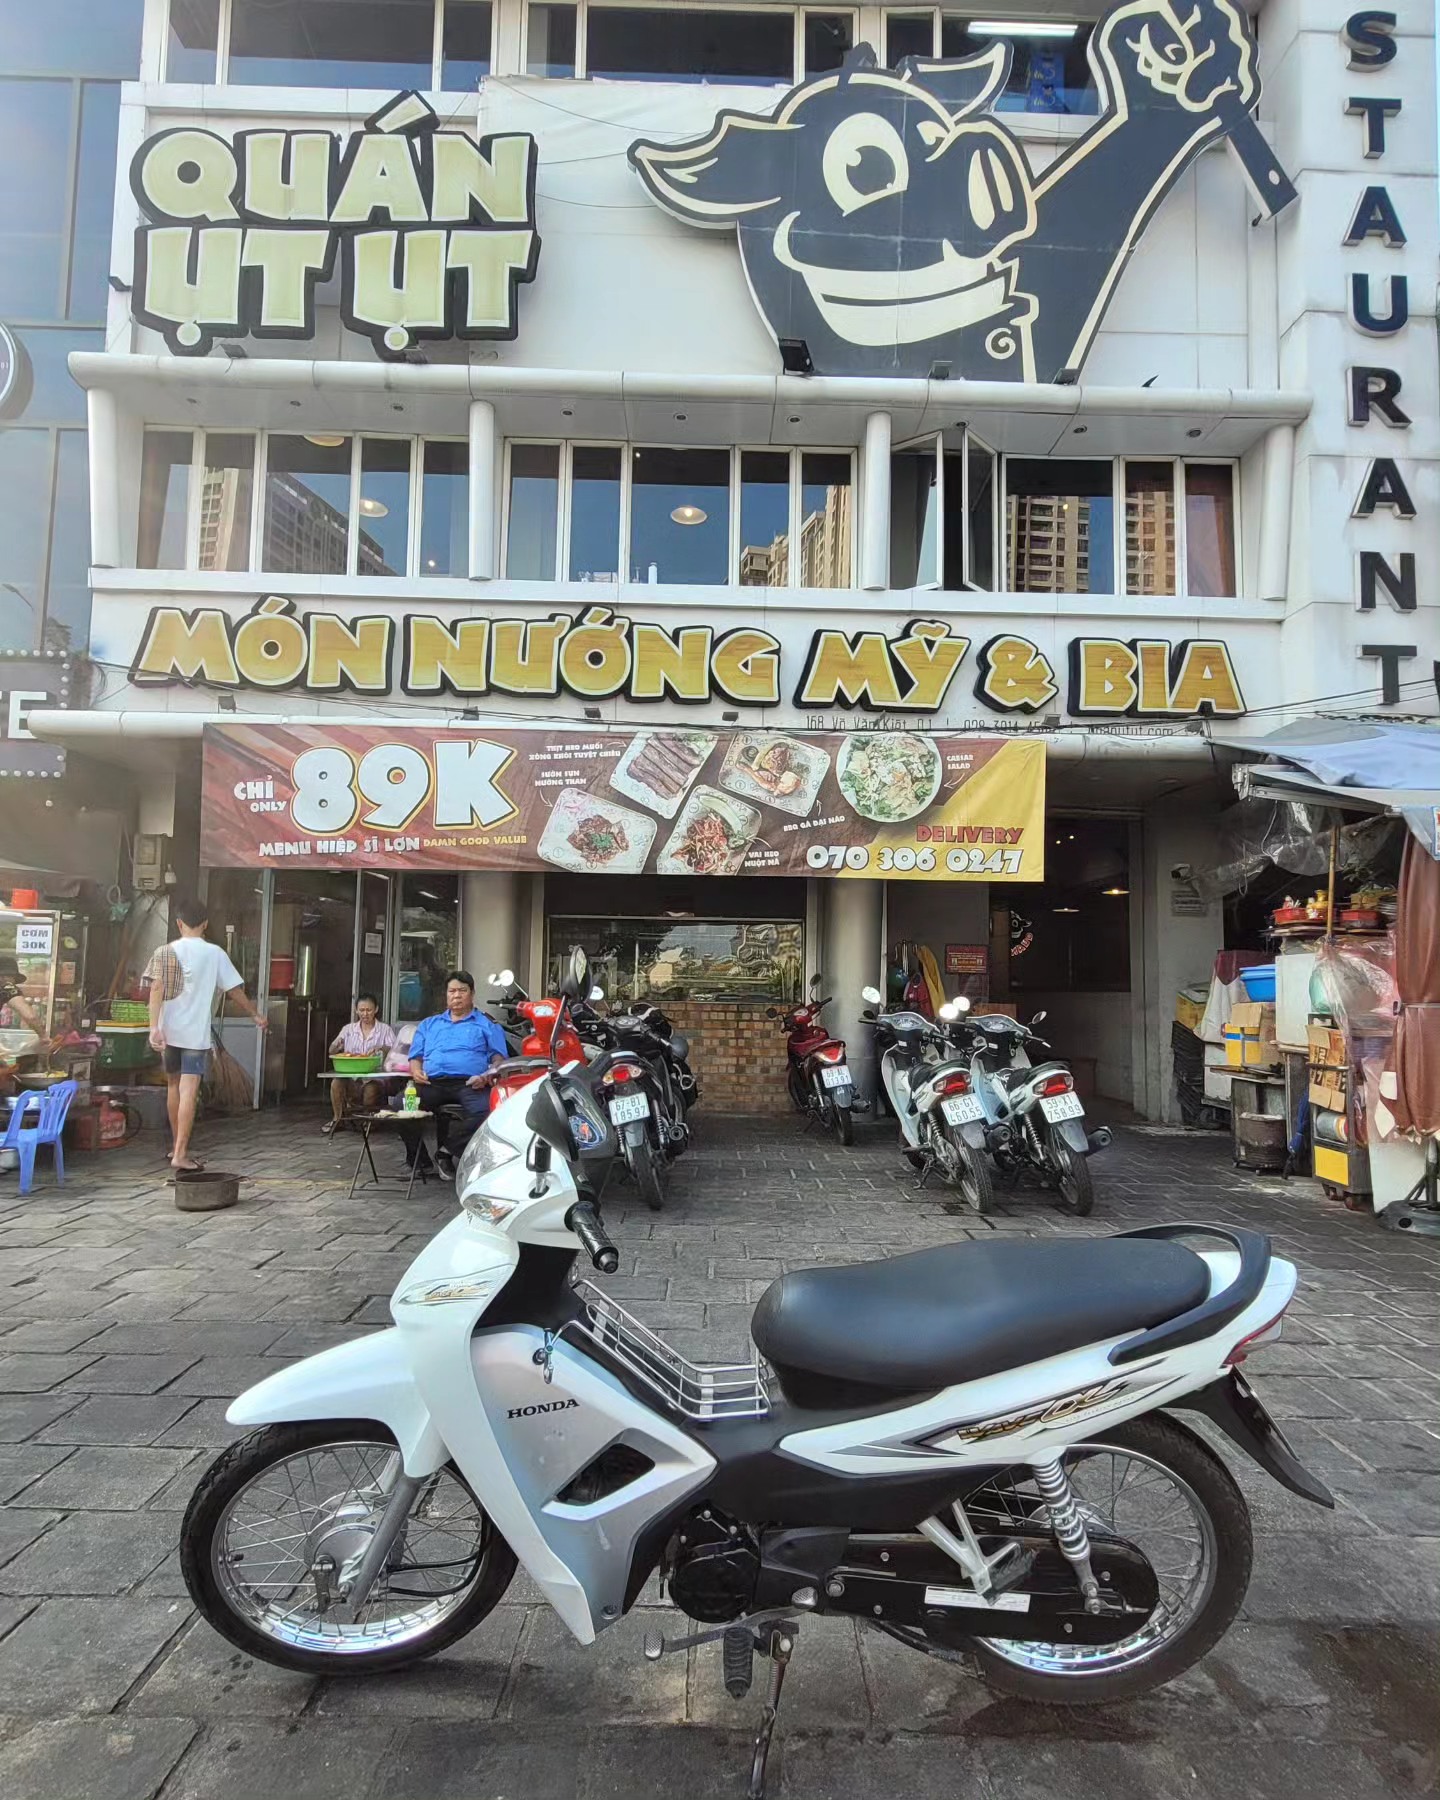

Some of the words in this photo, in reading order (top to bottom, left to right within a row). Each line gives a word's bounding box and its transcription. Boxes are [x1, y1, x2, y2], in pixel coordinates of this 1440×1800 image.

[134, 92, 536, 225] QUÁN
[140, 228, 333, 350] ỤT
[349, 229, 536, 353] ỤT
[132, 594, 394, 691] MÓN
[403, 606, 781, 705] NƯỚNG
[796, 618, 971, 712] MỸ
[977, 634, 1059, 712] &
[1070, 637, 1247, 716] BIA
[806, 715, 824, 730] 168
[947, 762, 971, 770] SALAD
[233, 774, 274, 801] CHỈ
[292, 739, 518, 834] 89K
[250, 800, 287, 813] ONLY
[258, 841, 311, 857] MENU
[316, 838, 357, 856] HIỆP
[423, 838, 456, 847] DAMN
[459, 836, 490, 846] GOOD
[494, 834, 527, 845] VALUE
[916, 824, 1024, 844] DELIVERY
[805, 844, 870, 870] 070
[876, 846, 937, 872] 306
[946, 847, 1024, 874] 0247
[22, 941, 46, 949] 30K
[507, 1398, 580, 1419] HONDA
